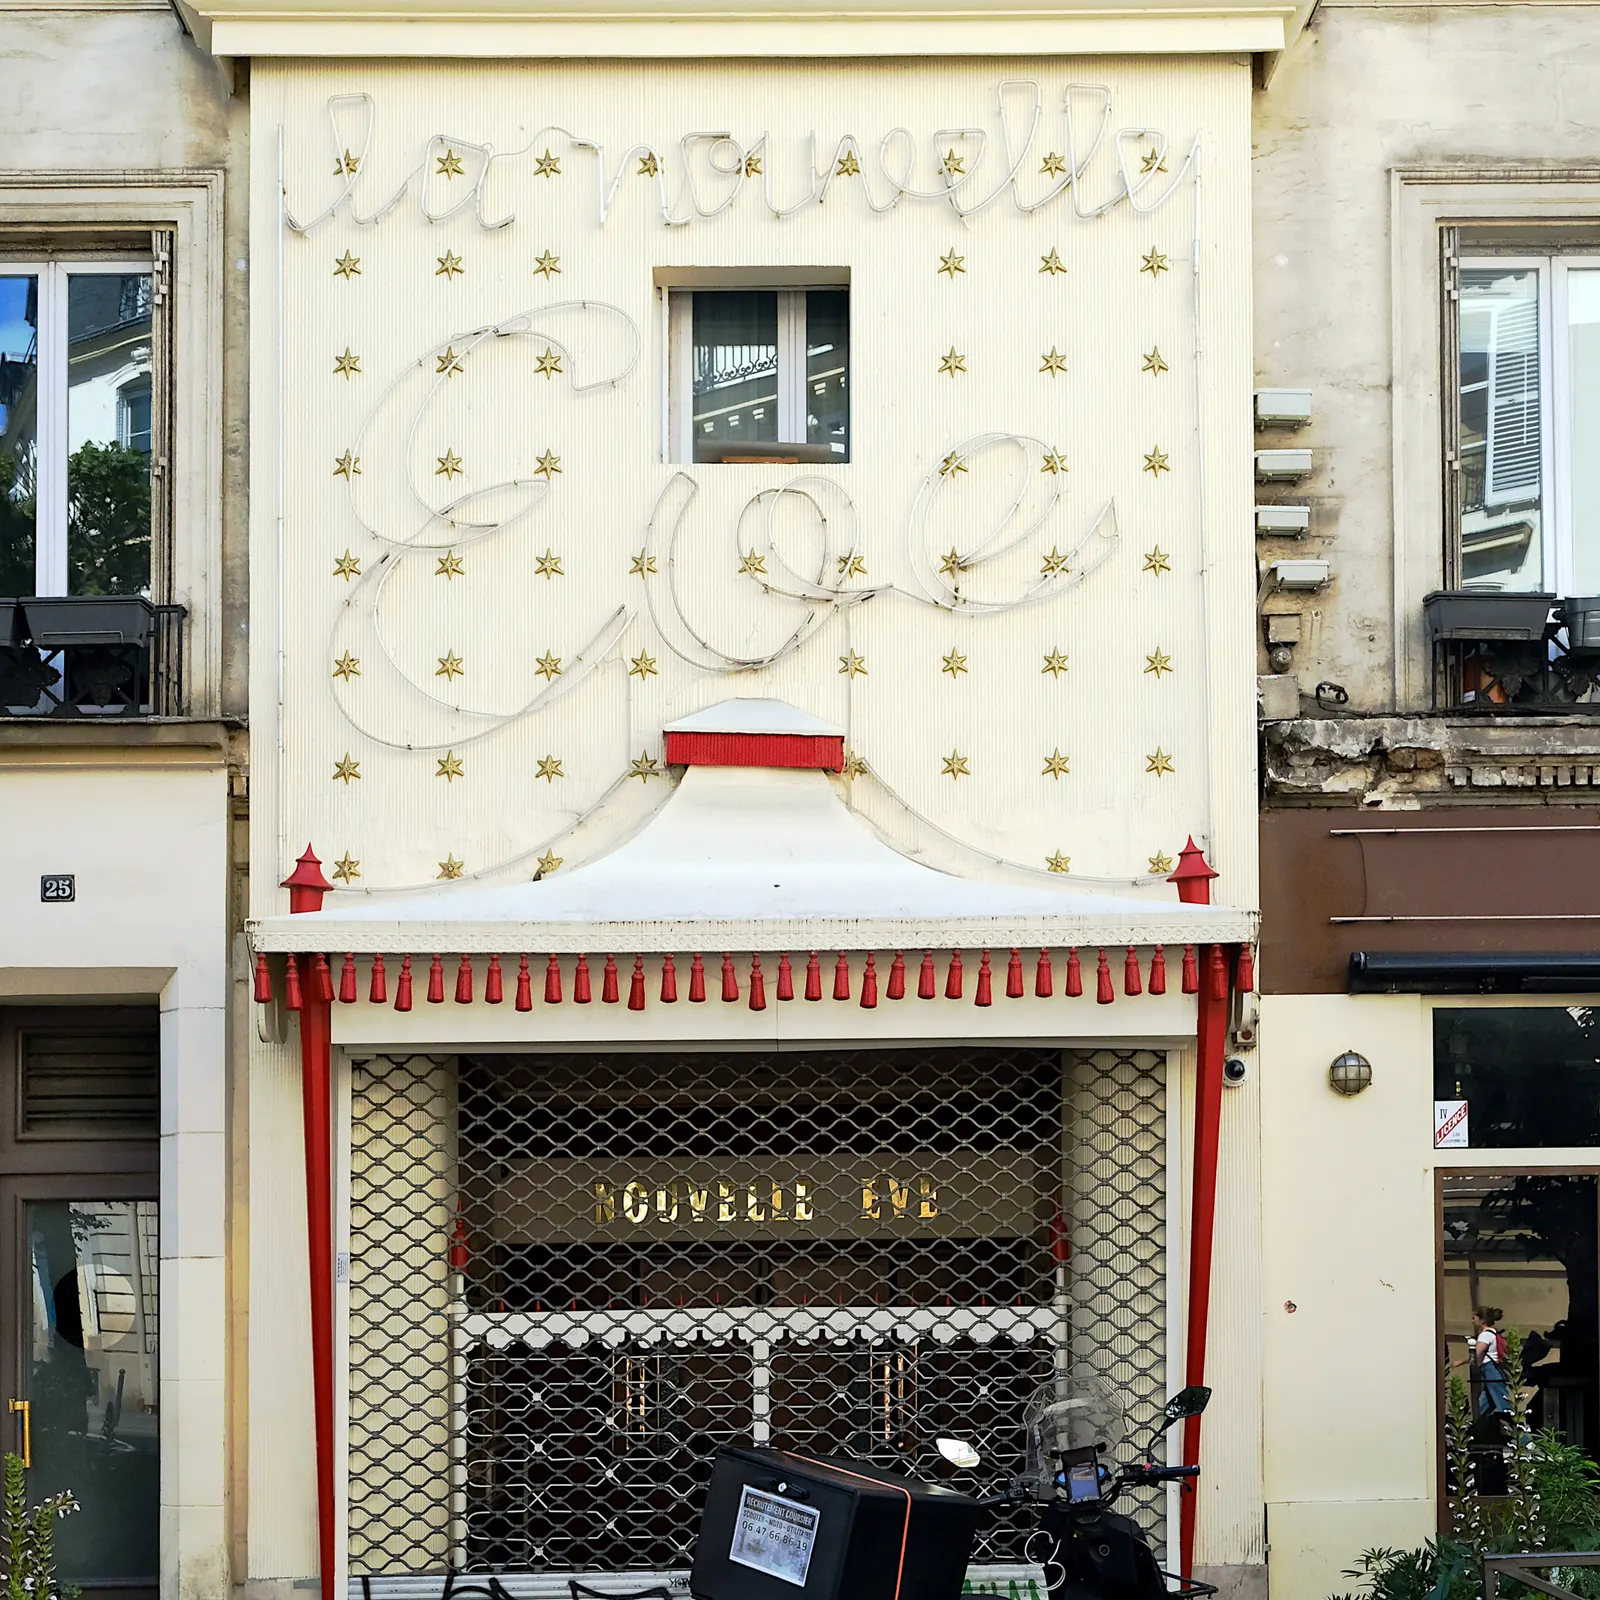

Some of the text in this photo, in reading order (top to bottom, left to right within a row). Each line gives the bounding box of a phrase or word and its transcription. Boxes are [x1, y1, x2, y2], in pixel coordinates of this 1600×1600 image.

[328, 300, 1121, 750] Eve
[45, 880, 71, 897] 25
[1436, 1103, 1467, 1142] LICENCE
[1440, 1108, 1448, 1119] IV
[594, 1177, 939, 1224] NOUVELLE EVE
[743, 1509, 766, 1522] SCOOTER
[769, 1517, 783, 1530] MOTO
[745, 1496, 814, 1528] RECRUTEMENT COURSIER
[742, 1520, 808, 1551] 06 47 66 86 19
